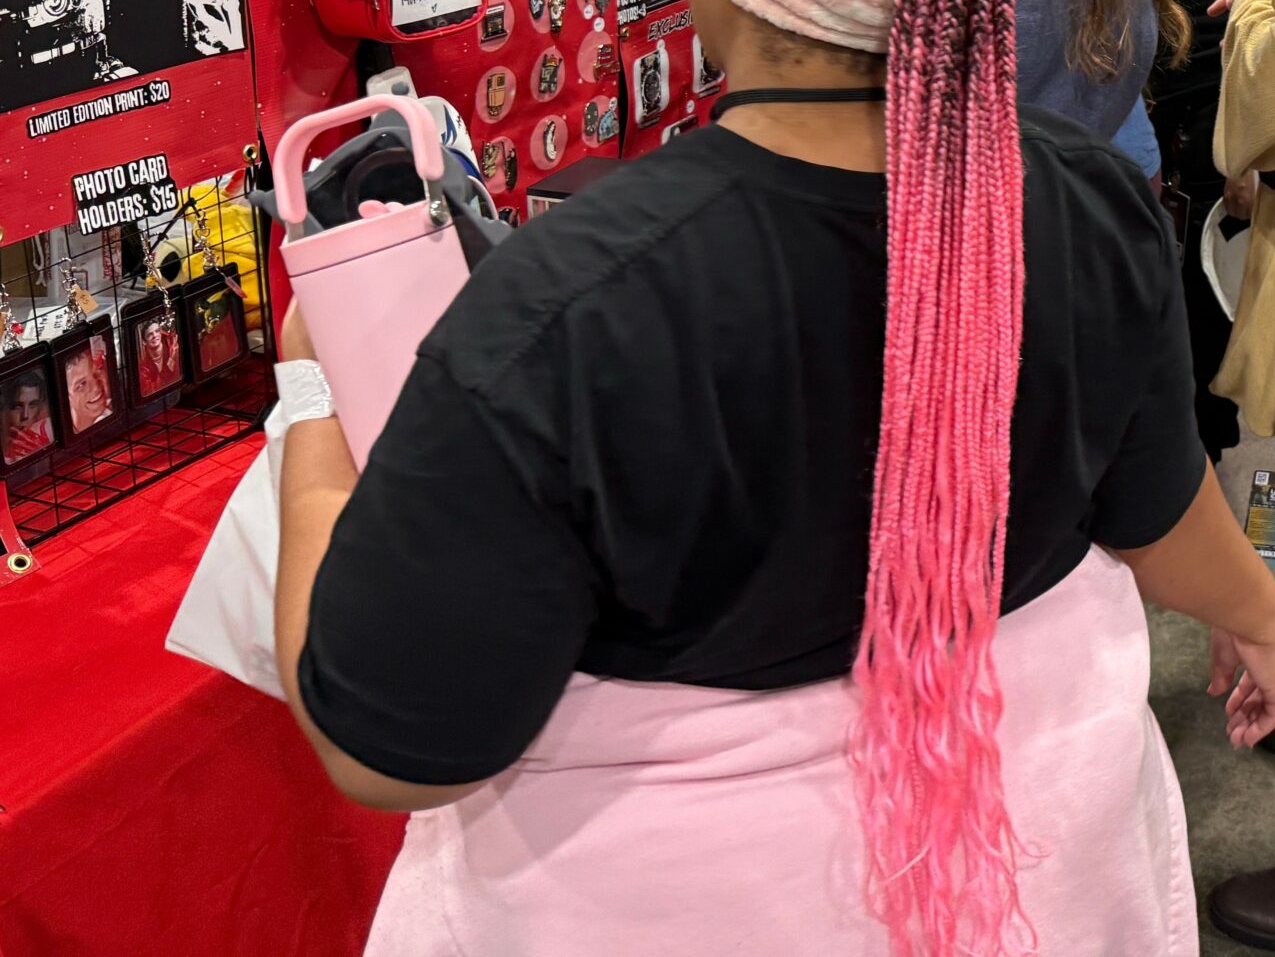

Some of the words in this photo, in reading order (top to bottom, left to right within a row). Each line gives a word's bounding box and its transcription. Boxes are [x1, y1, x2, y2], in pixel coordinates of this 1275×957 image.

[29, 110, 71, 138] LIMITED
[73, 97, 113, 125] EDITION
[115, 87, 148, 113] PRINT:
[149, 80, 170, 104] $20
[74, 166, 127, 202] PHOTO
[128, 155, 168, 186] CARD
[77, 196, 149, 235] HOLDERS:
[150, 182, 176, 214] $15
